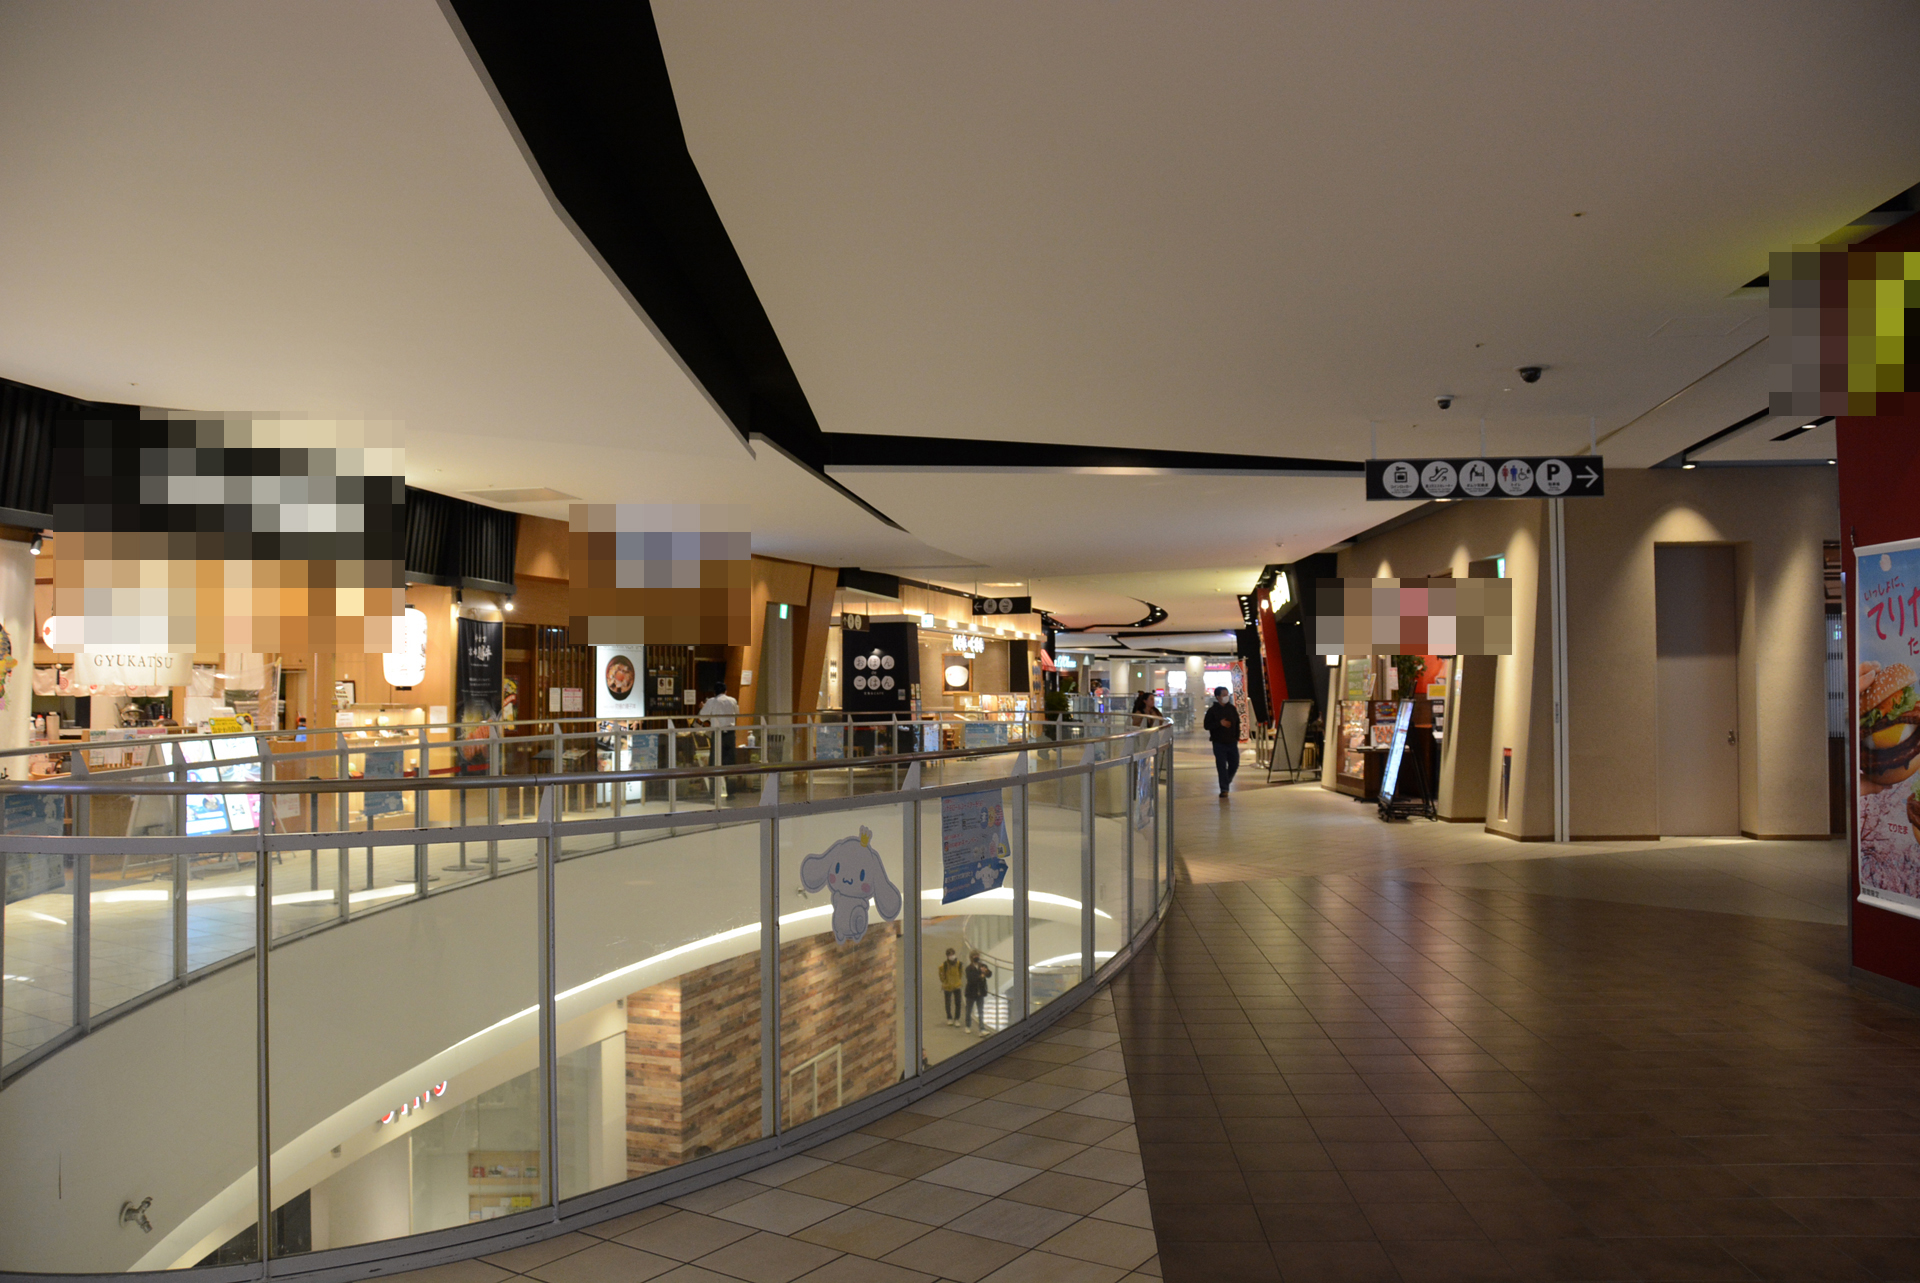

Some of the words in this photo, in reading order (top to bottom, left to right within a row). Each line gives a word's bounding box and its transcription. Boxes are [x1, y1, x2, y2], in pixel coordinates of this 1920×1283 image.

[94, 654, 174, 669] GYUKATSU
[1373, 725, 1394, 735] TAK
[1376, 733, 1392, 743] OU
[1887, 822, 1909, 835] てりたま
